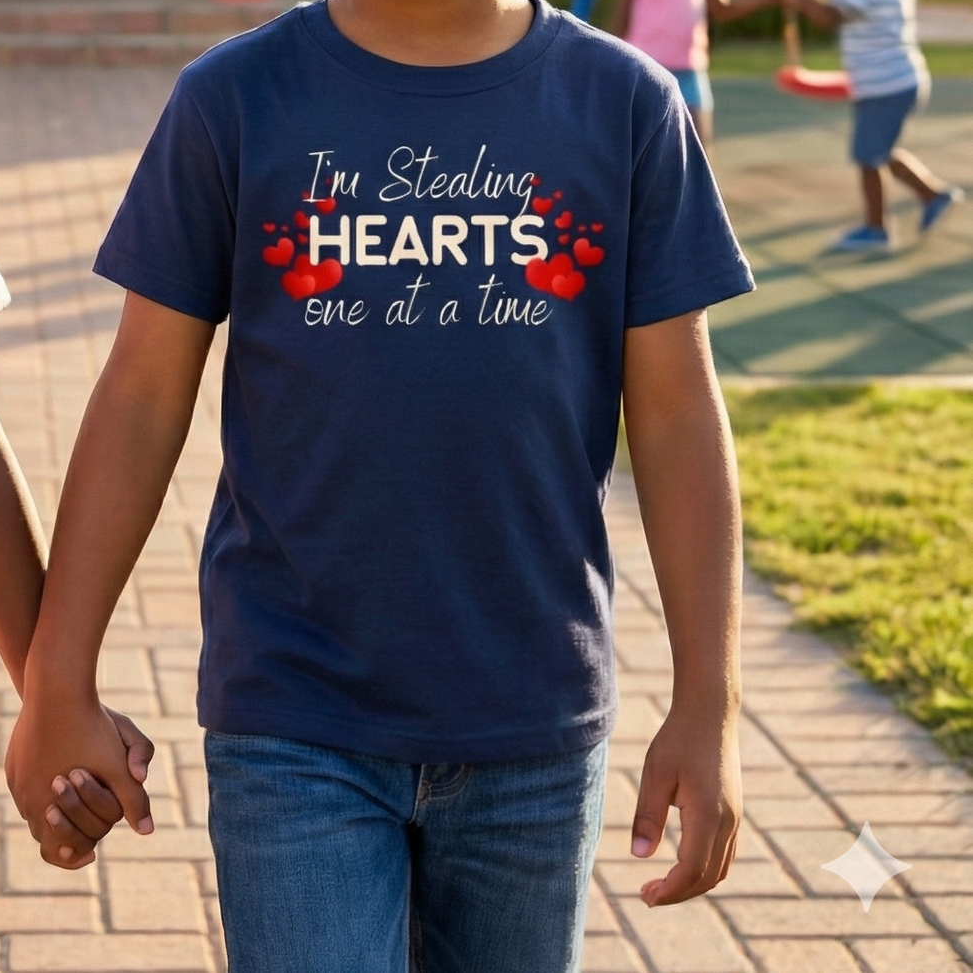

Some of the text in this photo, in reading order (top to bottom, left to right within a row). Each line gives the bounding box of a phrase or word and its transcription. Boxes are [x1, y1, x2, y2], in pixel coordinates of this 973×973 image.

[302, 144, 535, 222] I'm Stealing
[309, 215, 549, 266] HEARTS
[304, 273, 553, 326] one at a time
